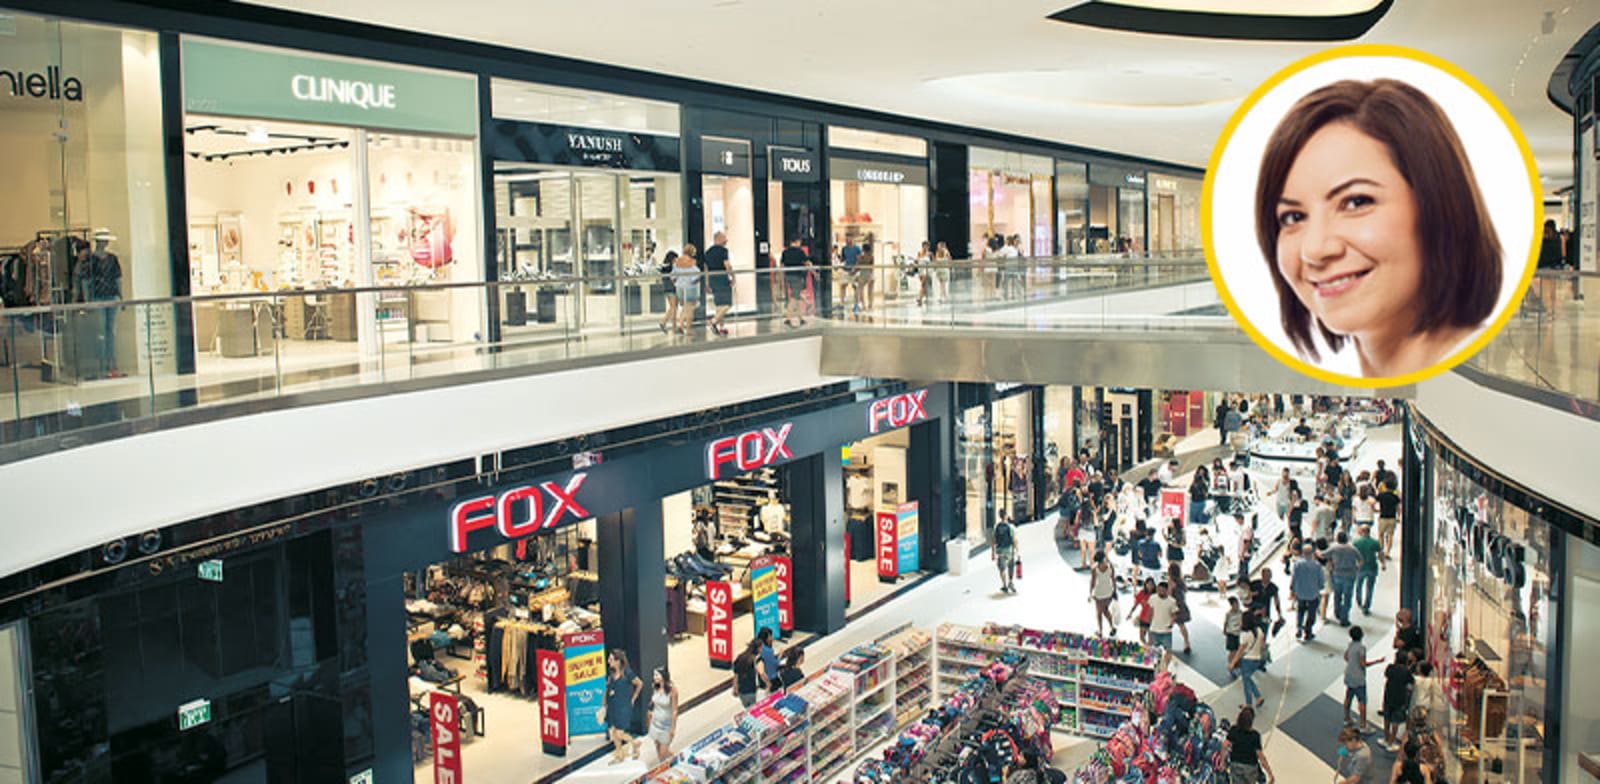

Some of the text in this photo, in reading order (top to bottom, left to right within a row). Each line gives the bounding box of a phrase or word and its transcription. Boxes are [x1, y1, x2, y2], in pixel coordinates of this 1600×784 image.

[291, 74, 397, 109] CLINIQUE
[567, 133, 623, 152] YANUSH
[781, 157, 811, 173] TOUS
[870, 390, 928, 432] FOX
[708, 423, 792, 480] FOX
[451, 472, 588, 553] FOX
[880, 517, 894, 572] SALE
[571, 634, 597, 644] FOX
[709, 586, 727, 656] SALE
[568, 655, 603, 673] SUPER
[573, 668, 599, 681] SALE
[542, 657, 560, 739] SALE
[434, 701, 455, 784] SALE
